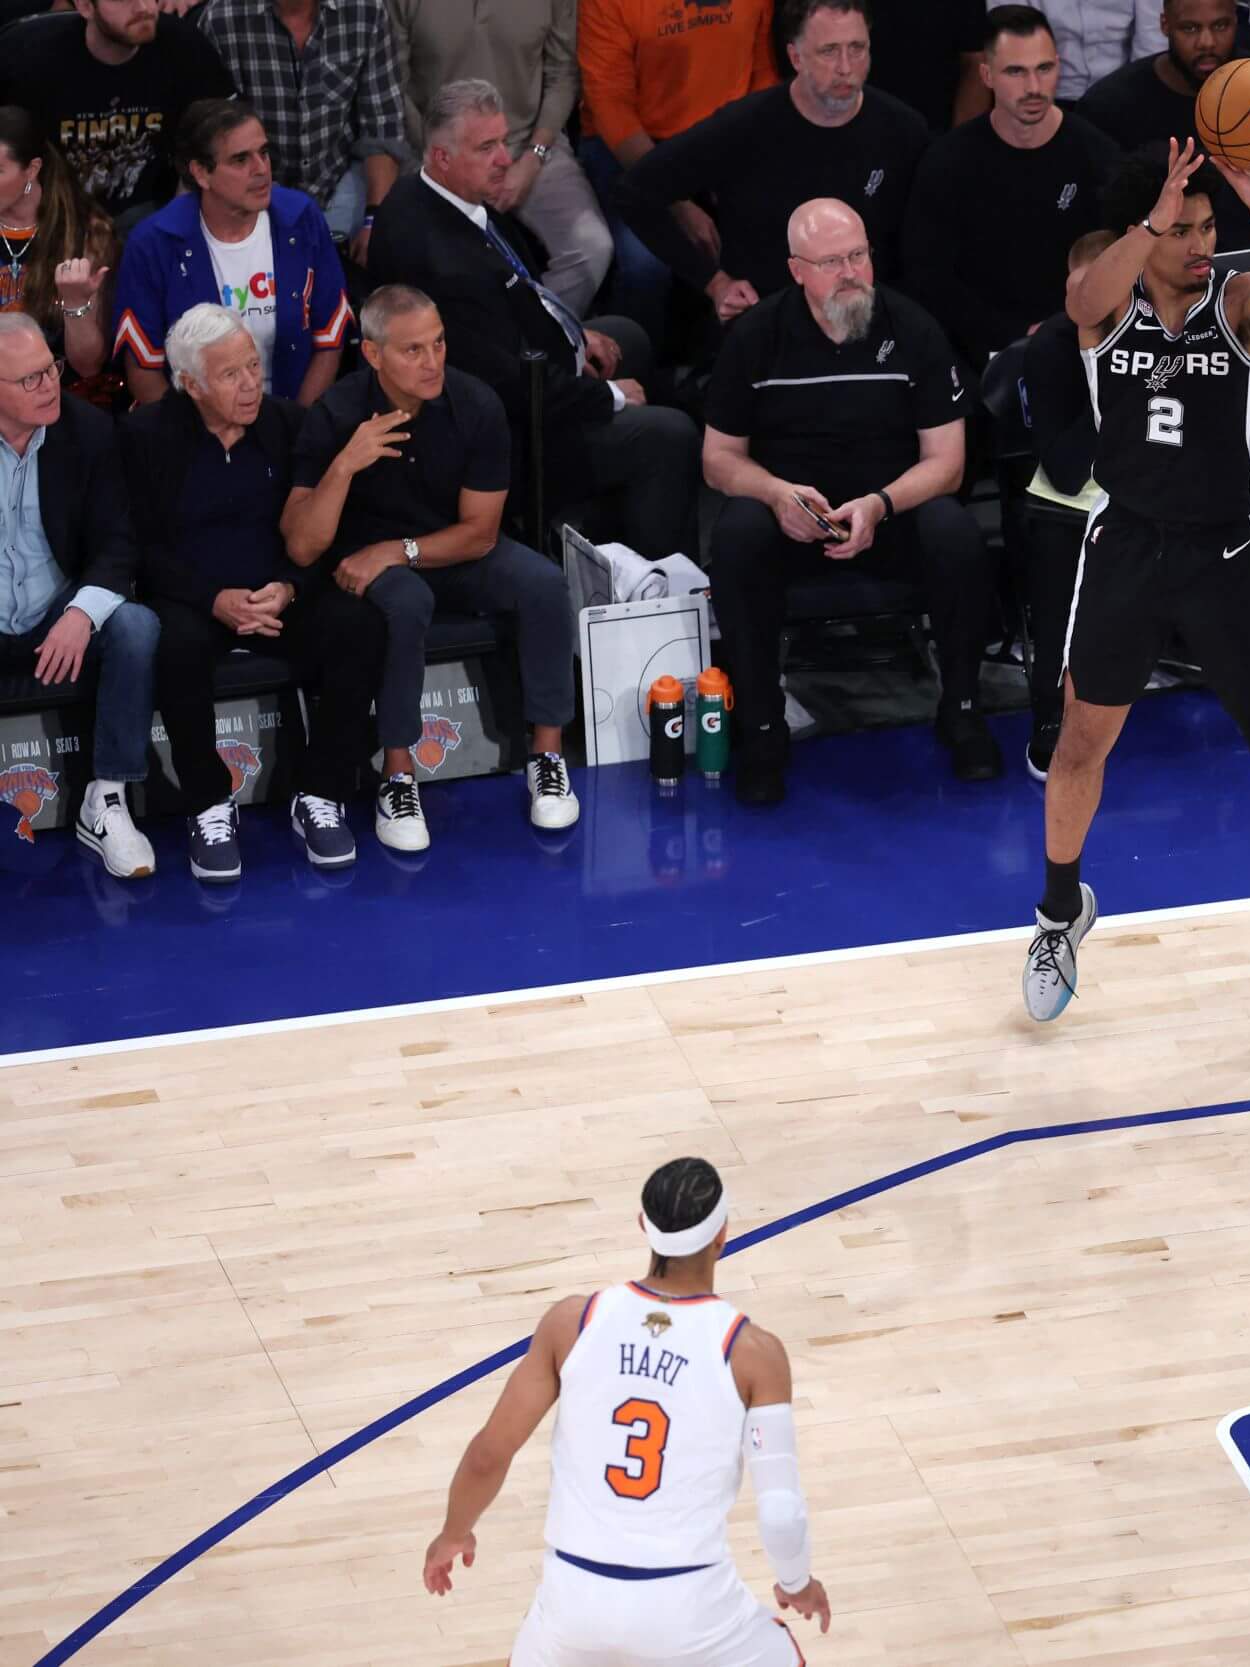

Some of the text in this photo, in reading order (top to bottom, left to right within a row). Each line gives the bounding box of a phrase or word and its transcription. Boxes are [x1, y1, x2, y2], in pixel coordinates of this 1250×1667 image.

[657, 10, 733, 37] LIVE SIMPLY
[1110, 350, 1231, 388] SPURS
[1146, 395, 1185, 447] 2
[457, 687, 474, 704] SEAT
[664, 715, 683, 739] G
[701, 712, 721, 733] G
[11, 736, 80, 759] ROW AA SEAT 3
[619, 1343, 689, 1387] HART
[604, 1397, 671, 1502] 3
